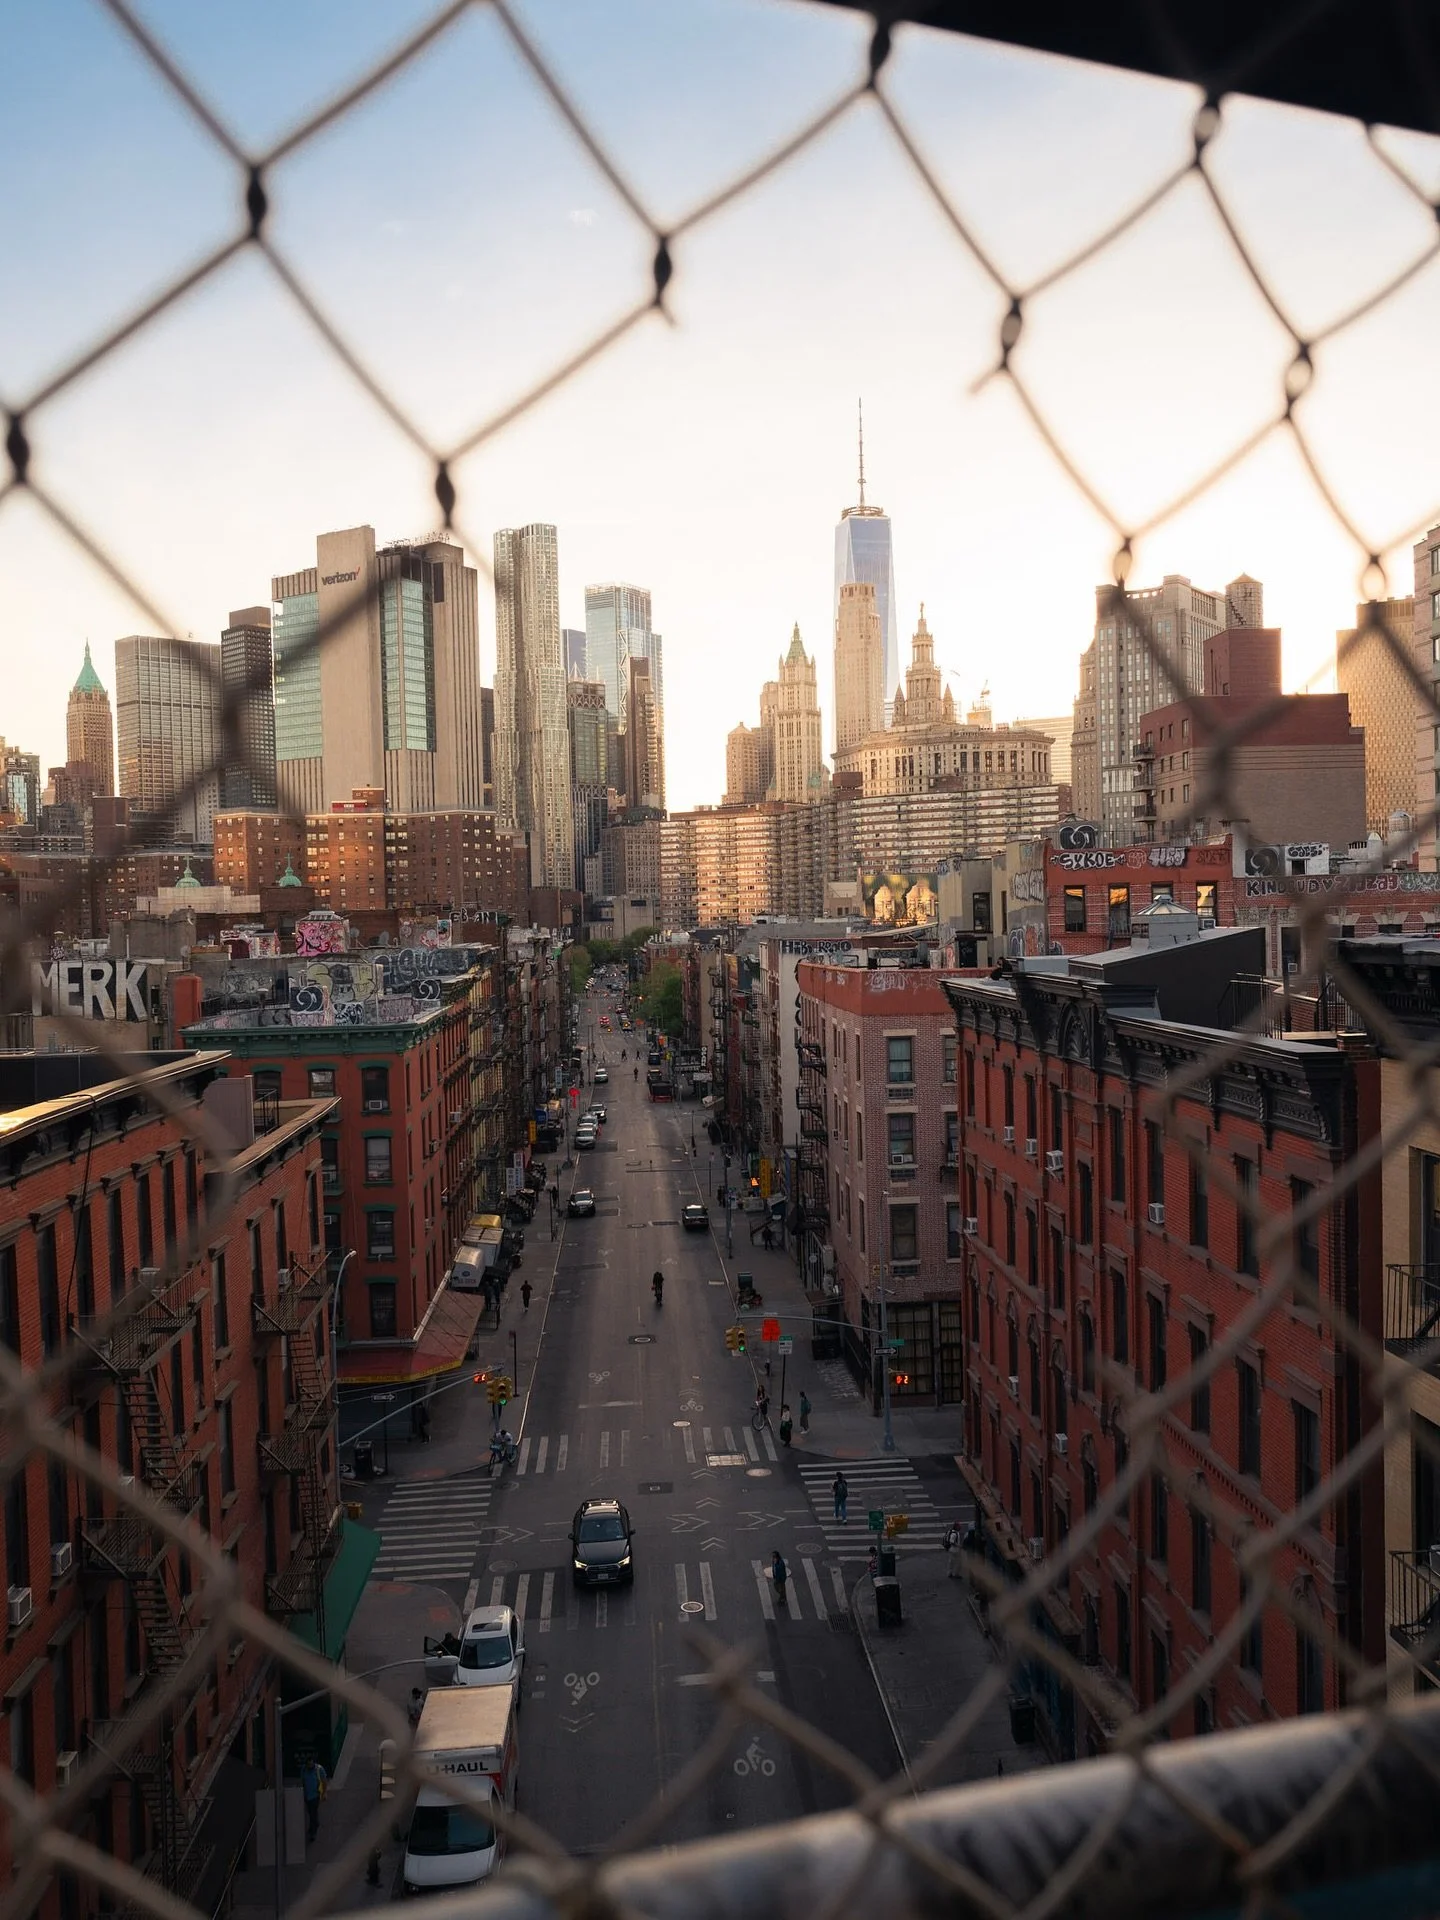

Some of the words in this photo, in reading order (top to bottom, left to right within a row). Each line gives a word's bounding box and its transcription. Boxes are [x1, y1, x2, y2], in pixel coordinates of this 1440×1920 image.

[321, 571, 356, 585] verizon
[32, 958, 148, 1023] MERK
[426, 1761, 489, 1776] U-HAUL
